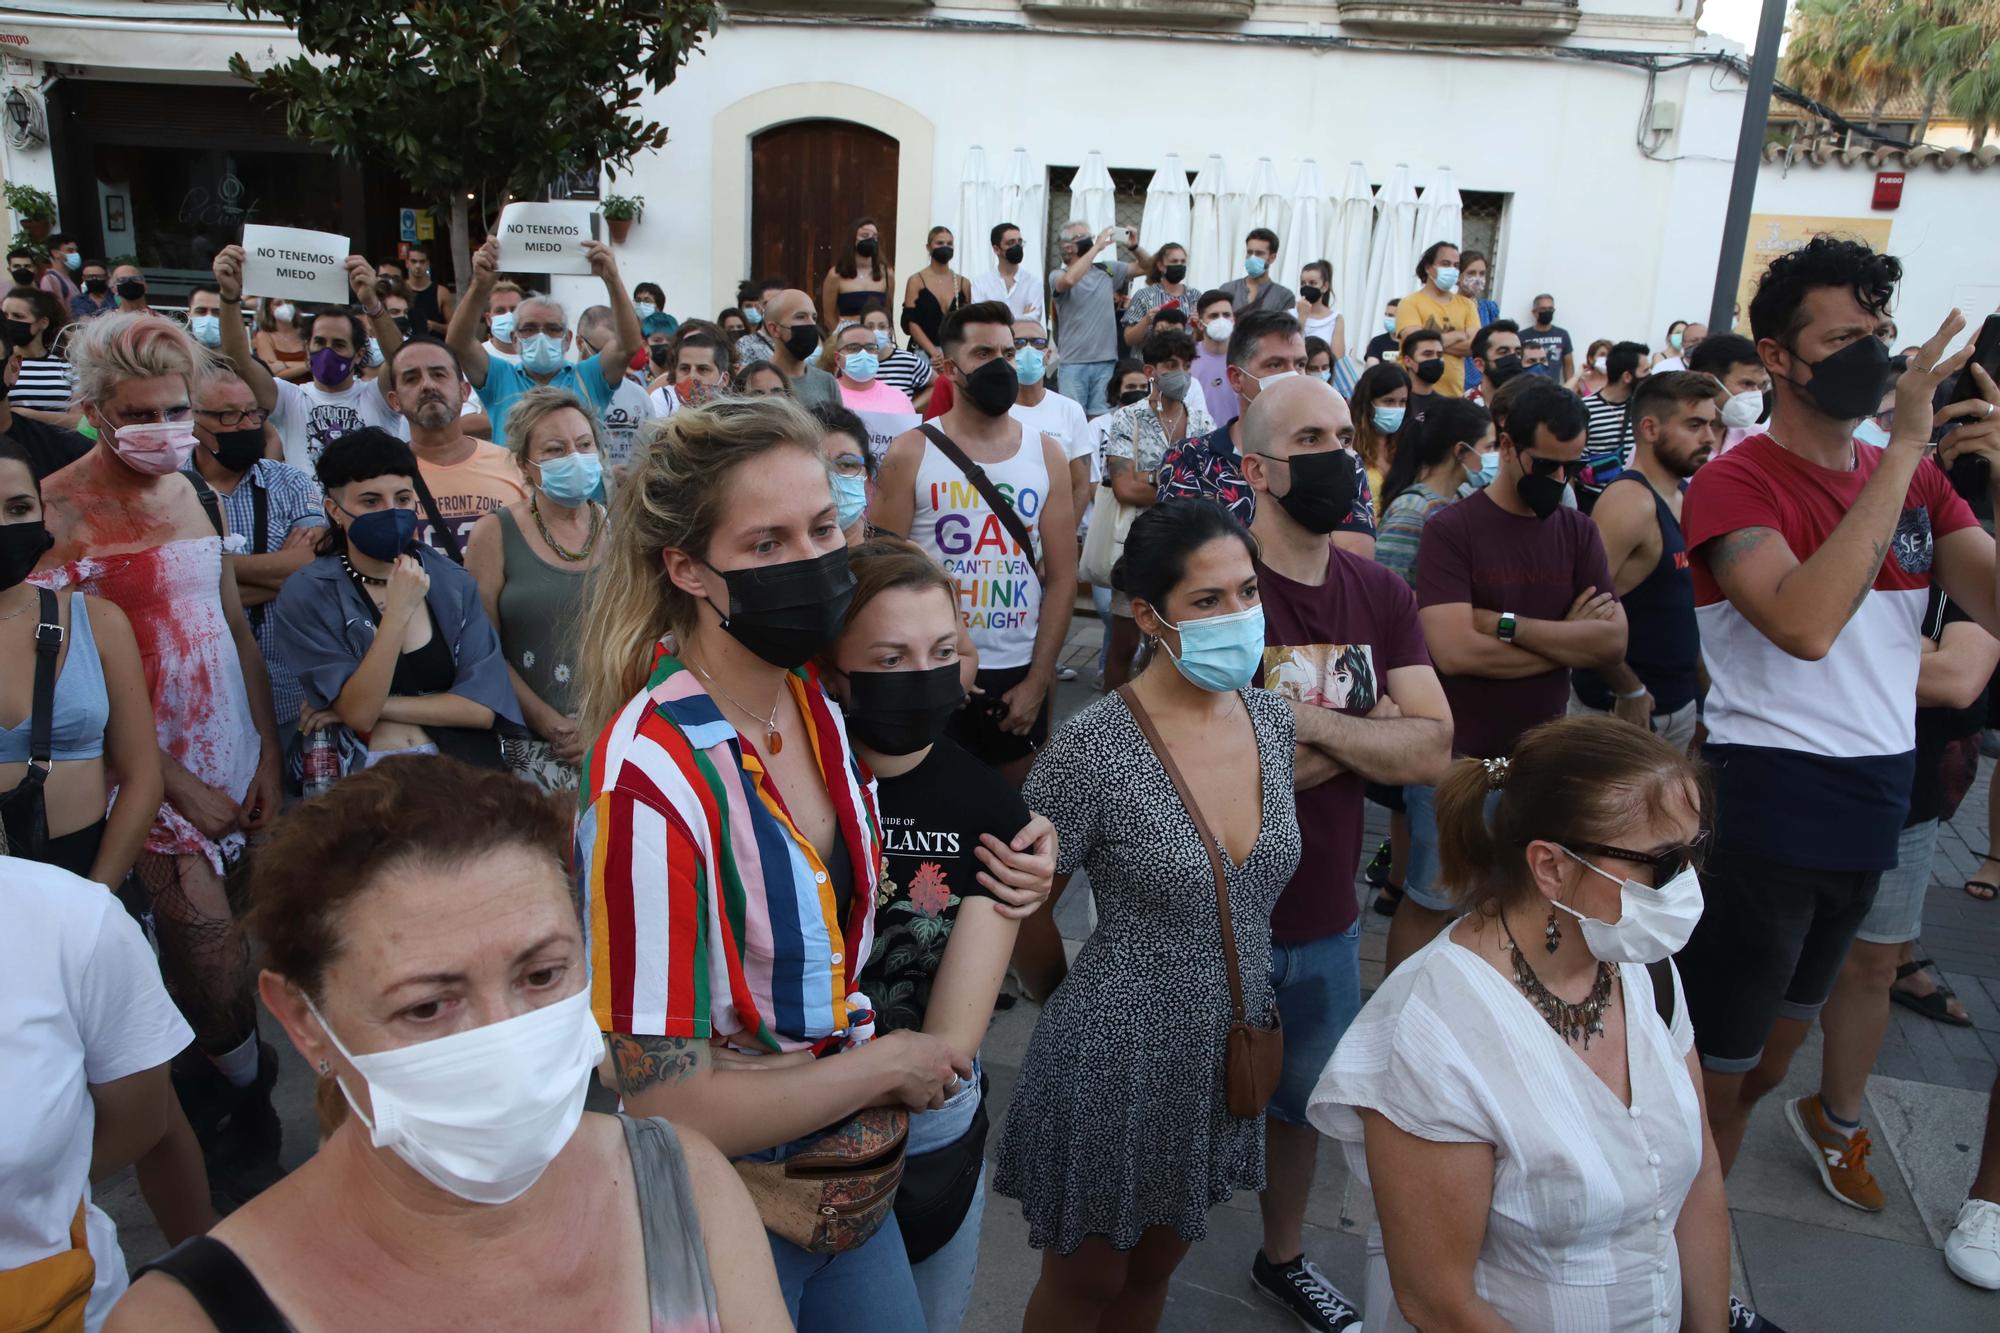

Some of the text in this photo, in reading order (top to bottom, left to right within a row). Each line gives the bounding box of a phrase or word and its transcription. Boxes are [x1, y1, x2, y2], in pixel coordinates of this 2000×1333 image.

[0, 34, 29, 46] ampo
[507, 224, 579, 236] NO TENEMOS
[525, 242, 562, 252] MIEDO
[257, 247, 334, 265] NO TENEMOS
[276, 268, 316, 280] MIEDO
[930, 480, 1039, 518] I'M SO
[943, 559, 1029, 574] CAN'T EVEN
[956, 578, 1028, 608] HINK
[960, 611, 1028, 629] RAIGHT
[881, 817, 915, 826] UIDE OF
